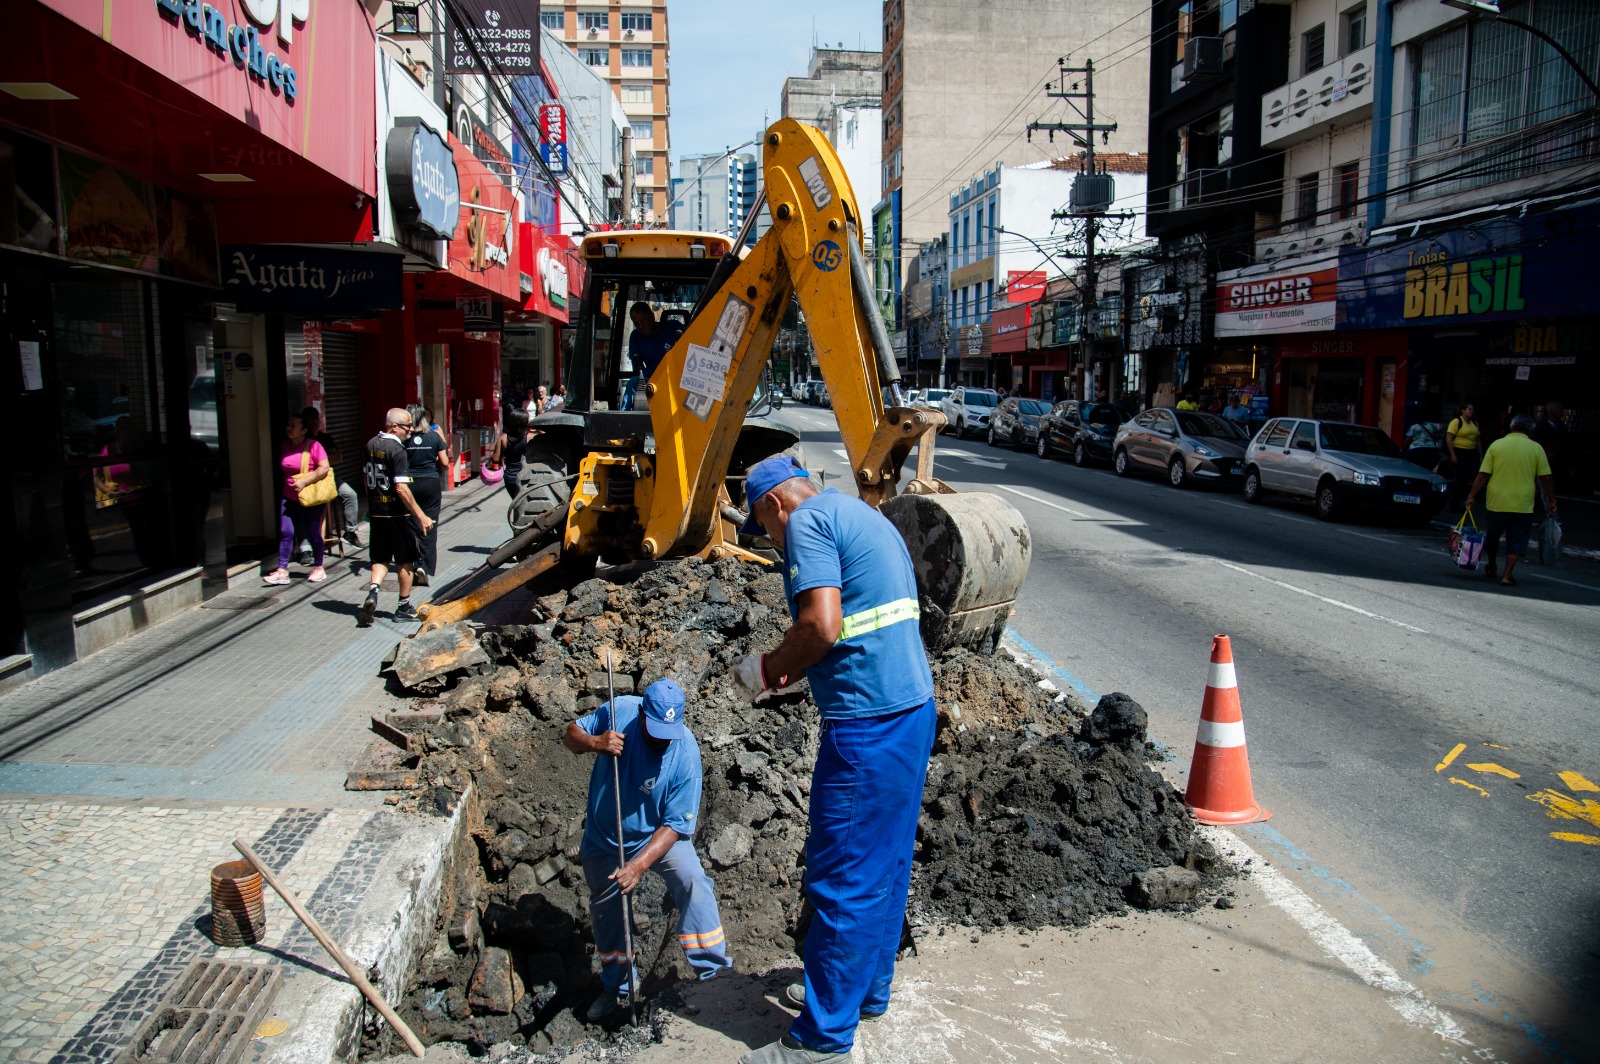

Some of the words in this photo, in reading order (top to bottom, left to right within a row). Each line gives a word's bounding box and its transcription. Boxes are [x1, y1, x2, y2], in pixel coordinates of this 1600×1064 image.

[1408, 248, 1446, 269] Lojas
[227, 251, 327, 293] Ágata
[1230, 277, 1313, 308] SINGER
[1403, 254, 1525, 319] BRASIL
[1269, 309, 1305, 319] Aviamentos
[1311, 340, 1354, 353] SINGER
[699, 358, 728, 373] saae
